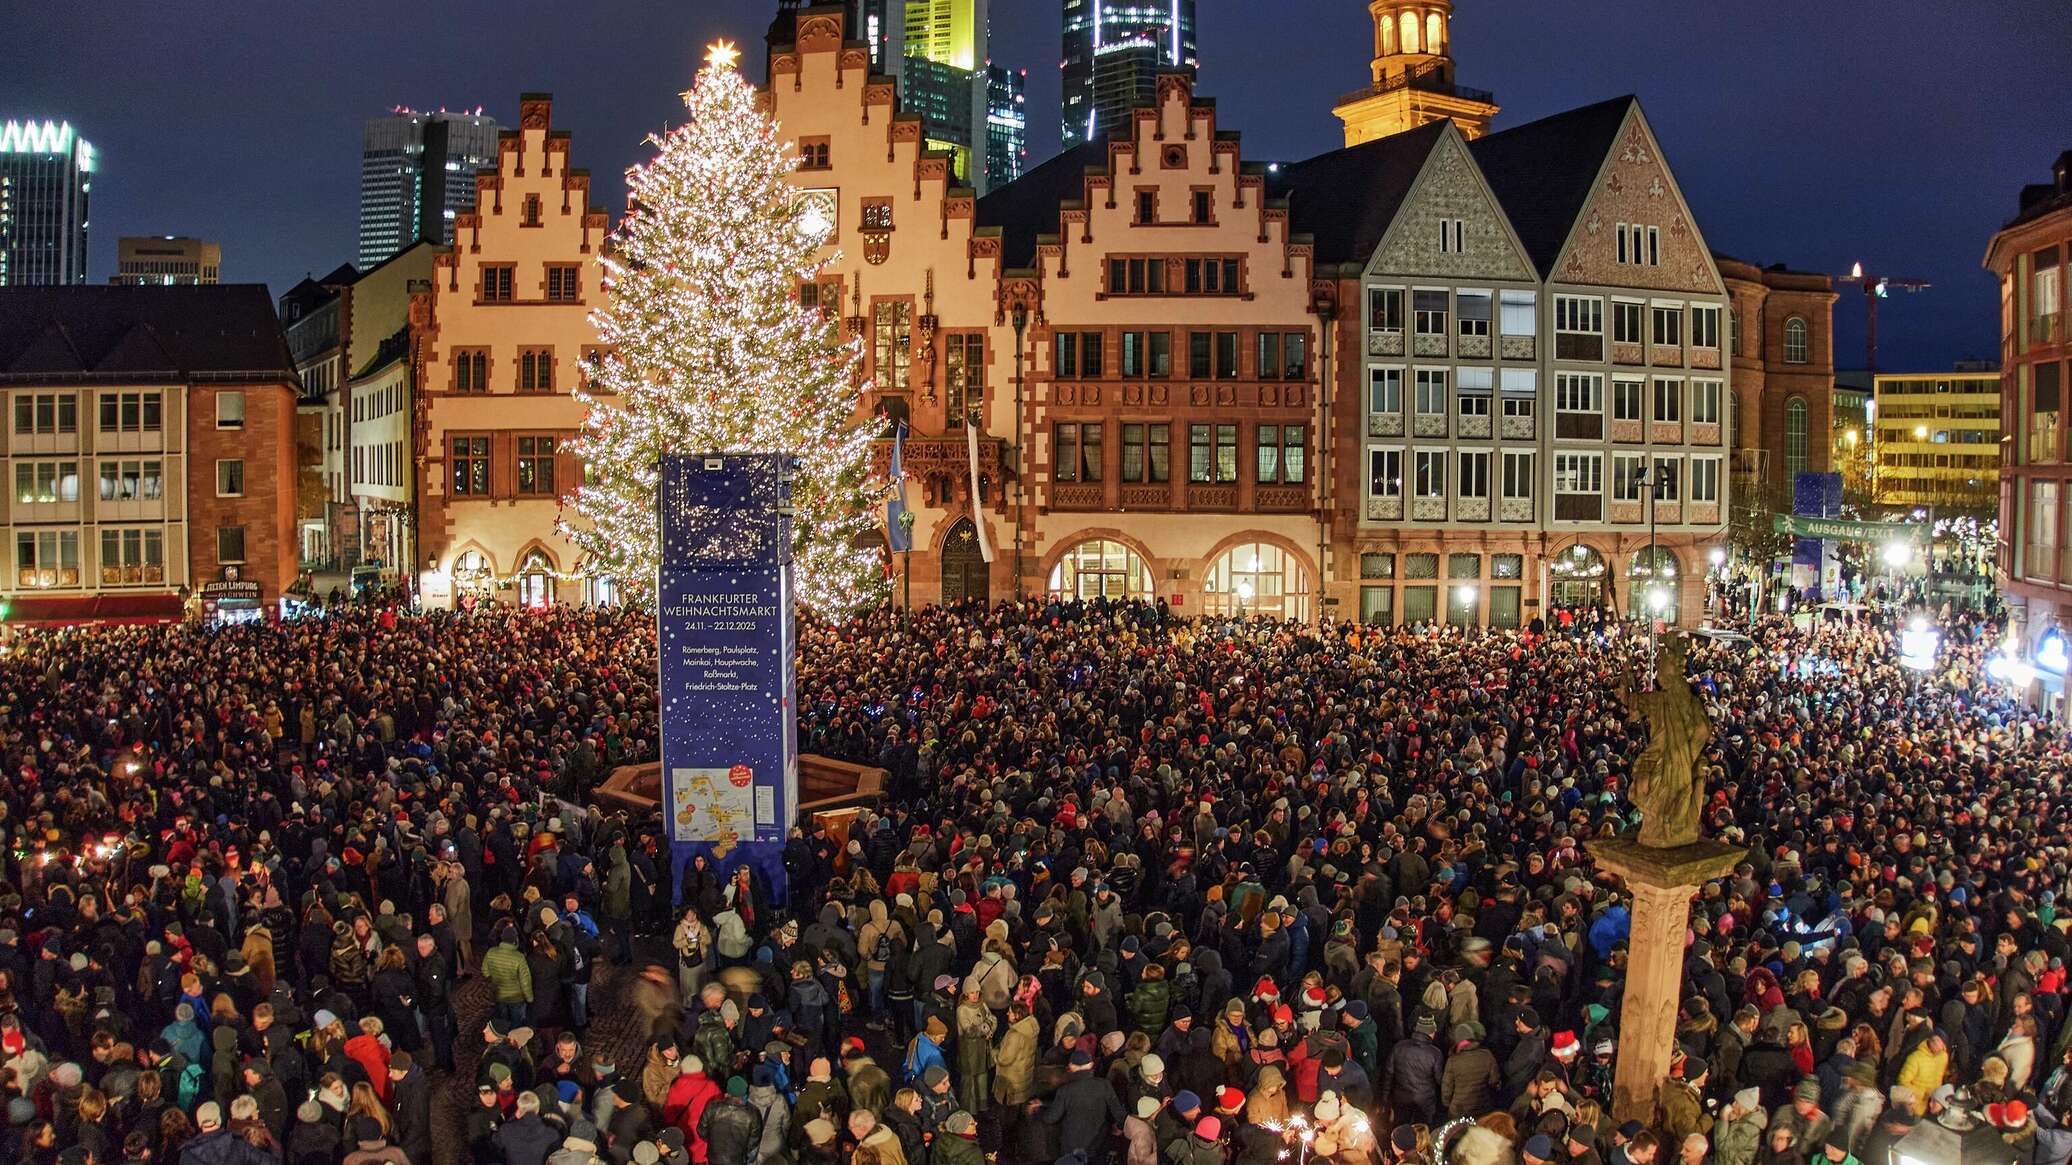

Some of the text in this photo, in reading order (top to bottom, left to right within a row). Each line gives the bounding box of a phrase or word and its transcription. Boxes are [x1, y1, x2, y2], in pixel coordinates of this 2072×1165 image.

[1807, 523, 1895, 538] AUSGANG/EXIT
[682, 593, 758, 604] FRANKFURTER
[663, 606, 777, 616] WEIHNACHTSMARKT
[685, 622, 706, 631] 24.11.
[714, 622, 756, 631] 22.12.2025
[682, 645, 760, 655] Römerberg, Paulsplatz,
[683, 658, 759, 668] Mainkai, Hauptwache,
[703, 670, 739, 680] Roßmarkt,
[685, 682, 758, 692] Friedrich-Stoltze-Platz
